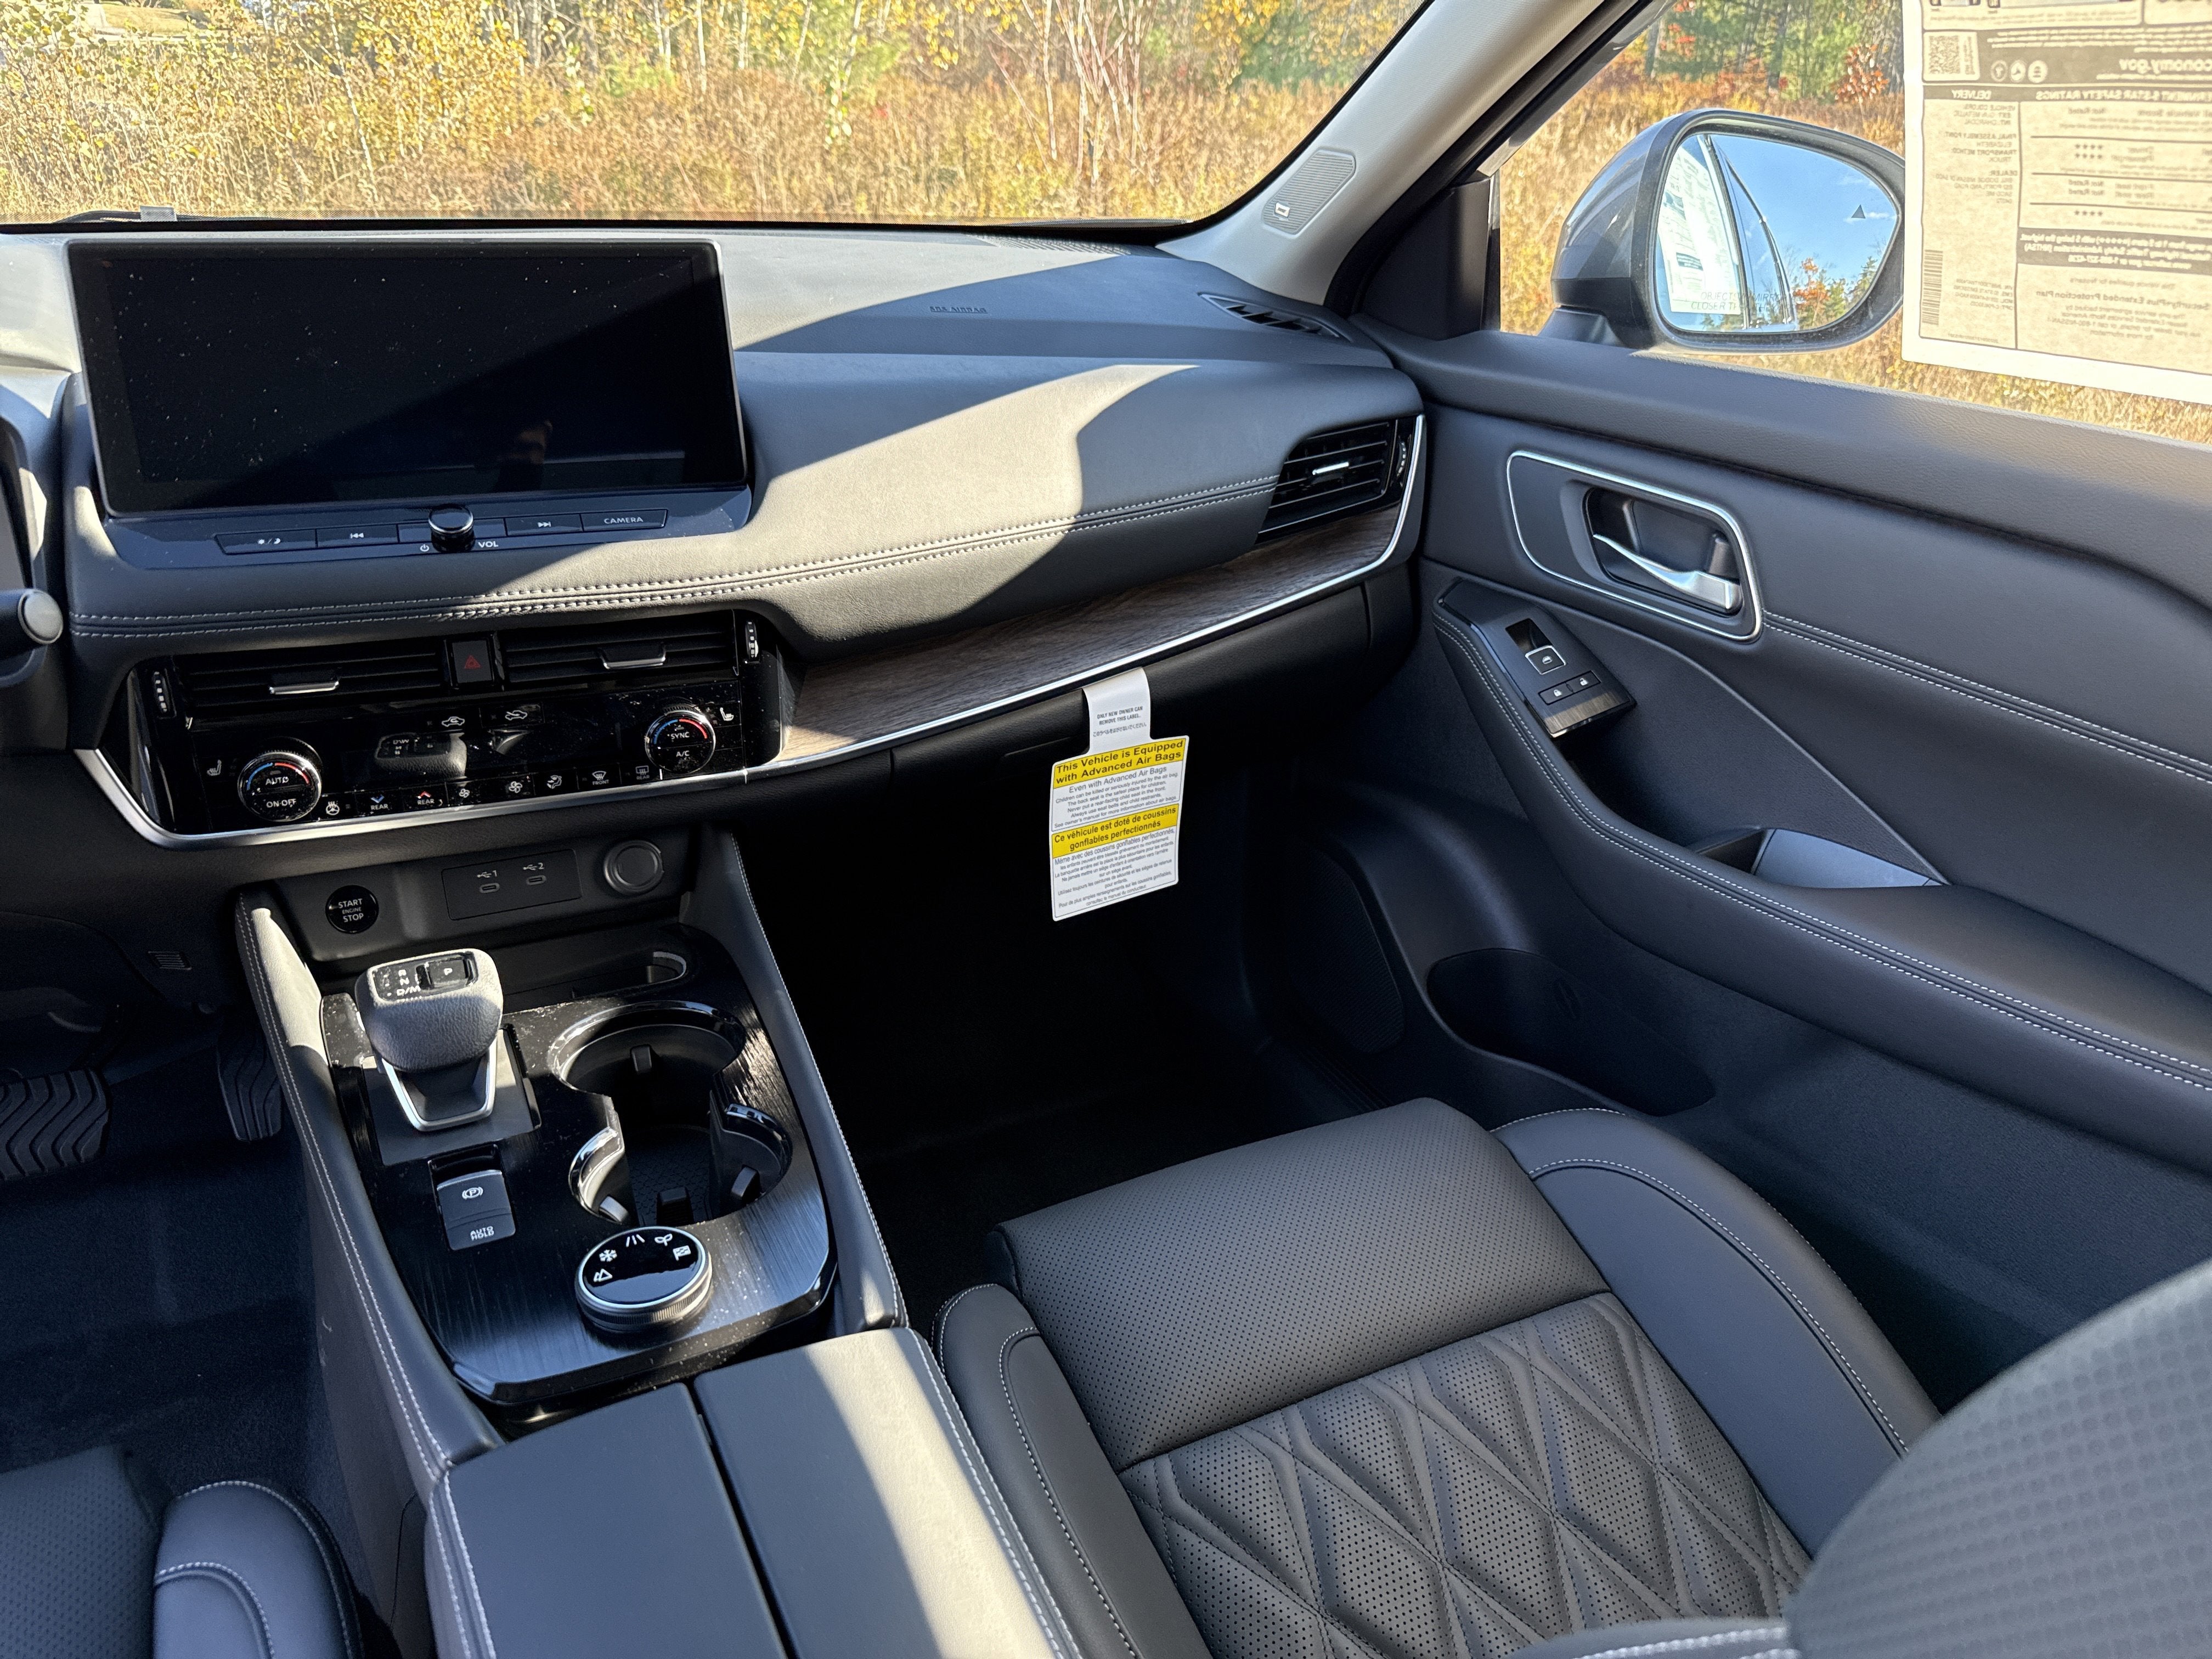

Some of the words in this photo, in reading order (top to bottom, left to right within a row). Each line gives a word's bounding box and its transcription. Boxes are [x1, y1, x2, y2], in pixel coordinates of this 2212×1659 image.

[1691, 302, 1726, 311] CLOSER
[603, 516, 644, 524] CAMERA
[670, 731, 690, 740] SYNC
[1058, 763, 1077, 773] This
[1082, 754, 1118, 767] Vehicle
[1133, 741, 1183, 757] Equipped
[1056, 772, 1076, 783] with
[1081, 760, 1132, 778] Advanced
[1136, 757, 1149, 766] Air
[1155, 752, 1181, 762] Bags
[265, 776, 289, 786] AUTO
[1069, 785, 1086, 793] Even
[1088, 780, 1102, 788] with
[1104, 772, 1136, 785] Advanced
[1054, 834, 1064, 842] Ce
[1067, 826, 1098, 839] véhicule
[1101, 821, 1111, 831] est
[1114, 817, 1130, 828] doté
[1132, 815, 1141, 823] de
[1143, 808, 1176, 821] coussins
[1070, 834, 1108, 851] gonflables
[1110, 820, 1160, 840] perfectionnés
[338, 898, 363, 909] START
[342, 906, 362, 915] ENGINE
[343, 913, 364, 923] STOP
[443, 967, 453, 976] P
[399, 977, 410, 986] N
[396, 985, 421, 996] D/M
[470, 1226, 493, 1235] AUTO
[471, 1231, 494, 1241] HOLD
